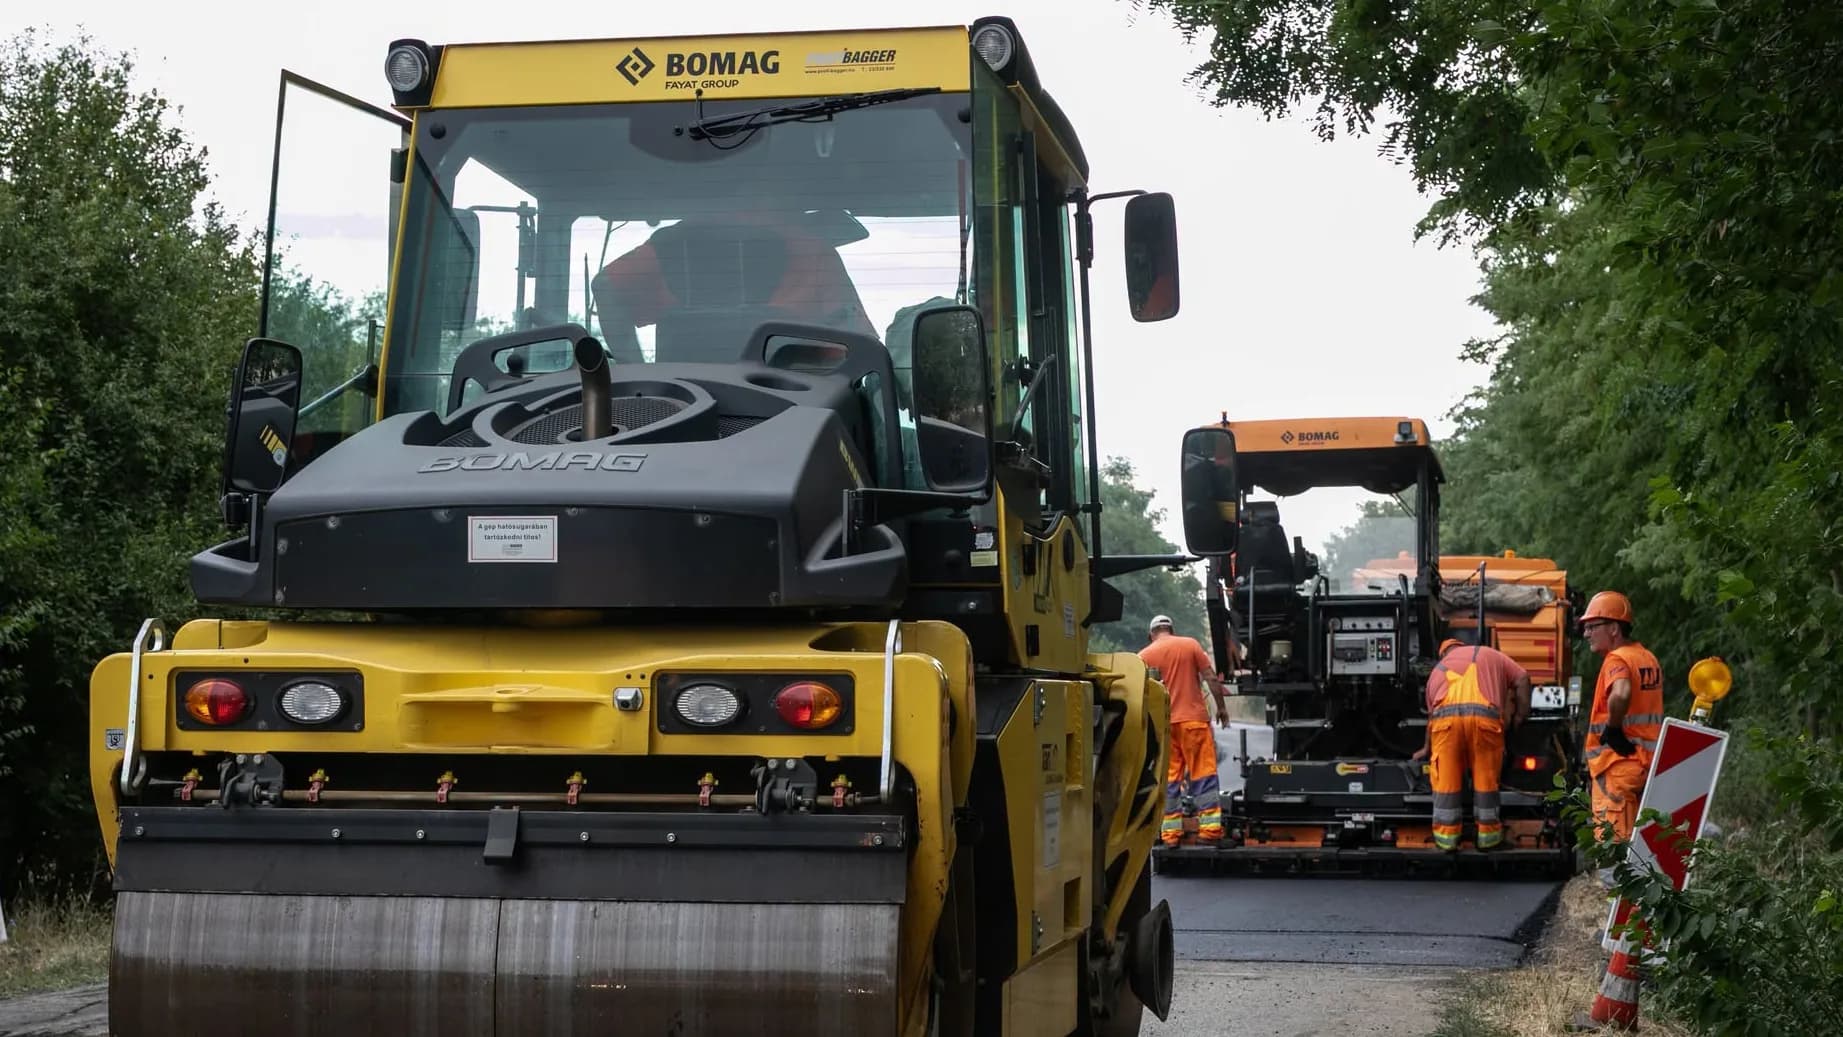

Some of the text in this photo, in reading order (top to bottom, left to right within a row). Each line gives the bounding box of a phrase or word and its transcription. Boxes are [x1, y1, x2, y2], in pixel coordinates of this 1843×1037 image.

[666, 50, 780, 77] BOMAG
[665, 79, 740, 90] FAYAT GROUP
[1298, 431, 1339, 441] BOMAG
[416, 452, 649, 474] BOMAG
